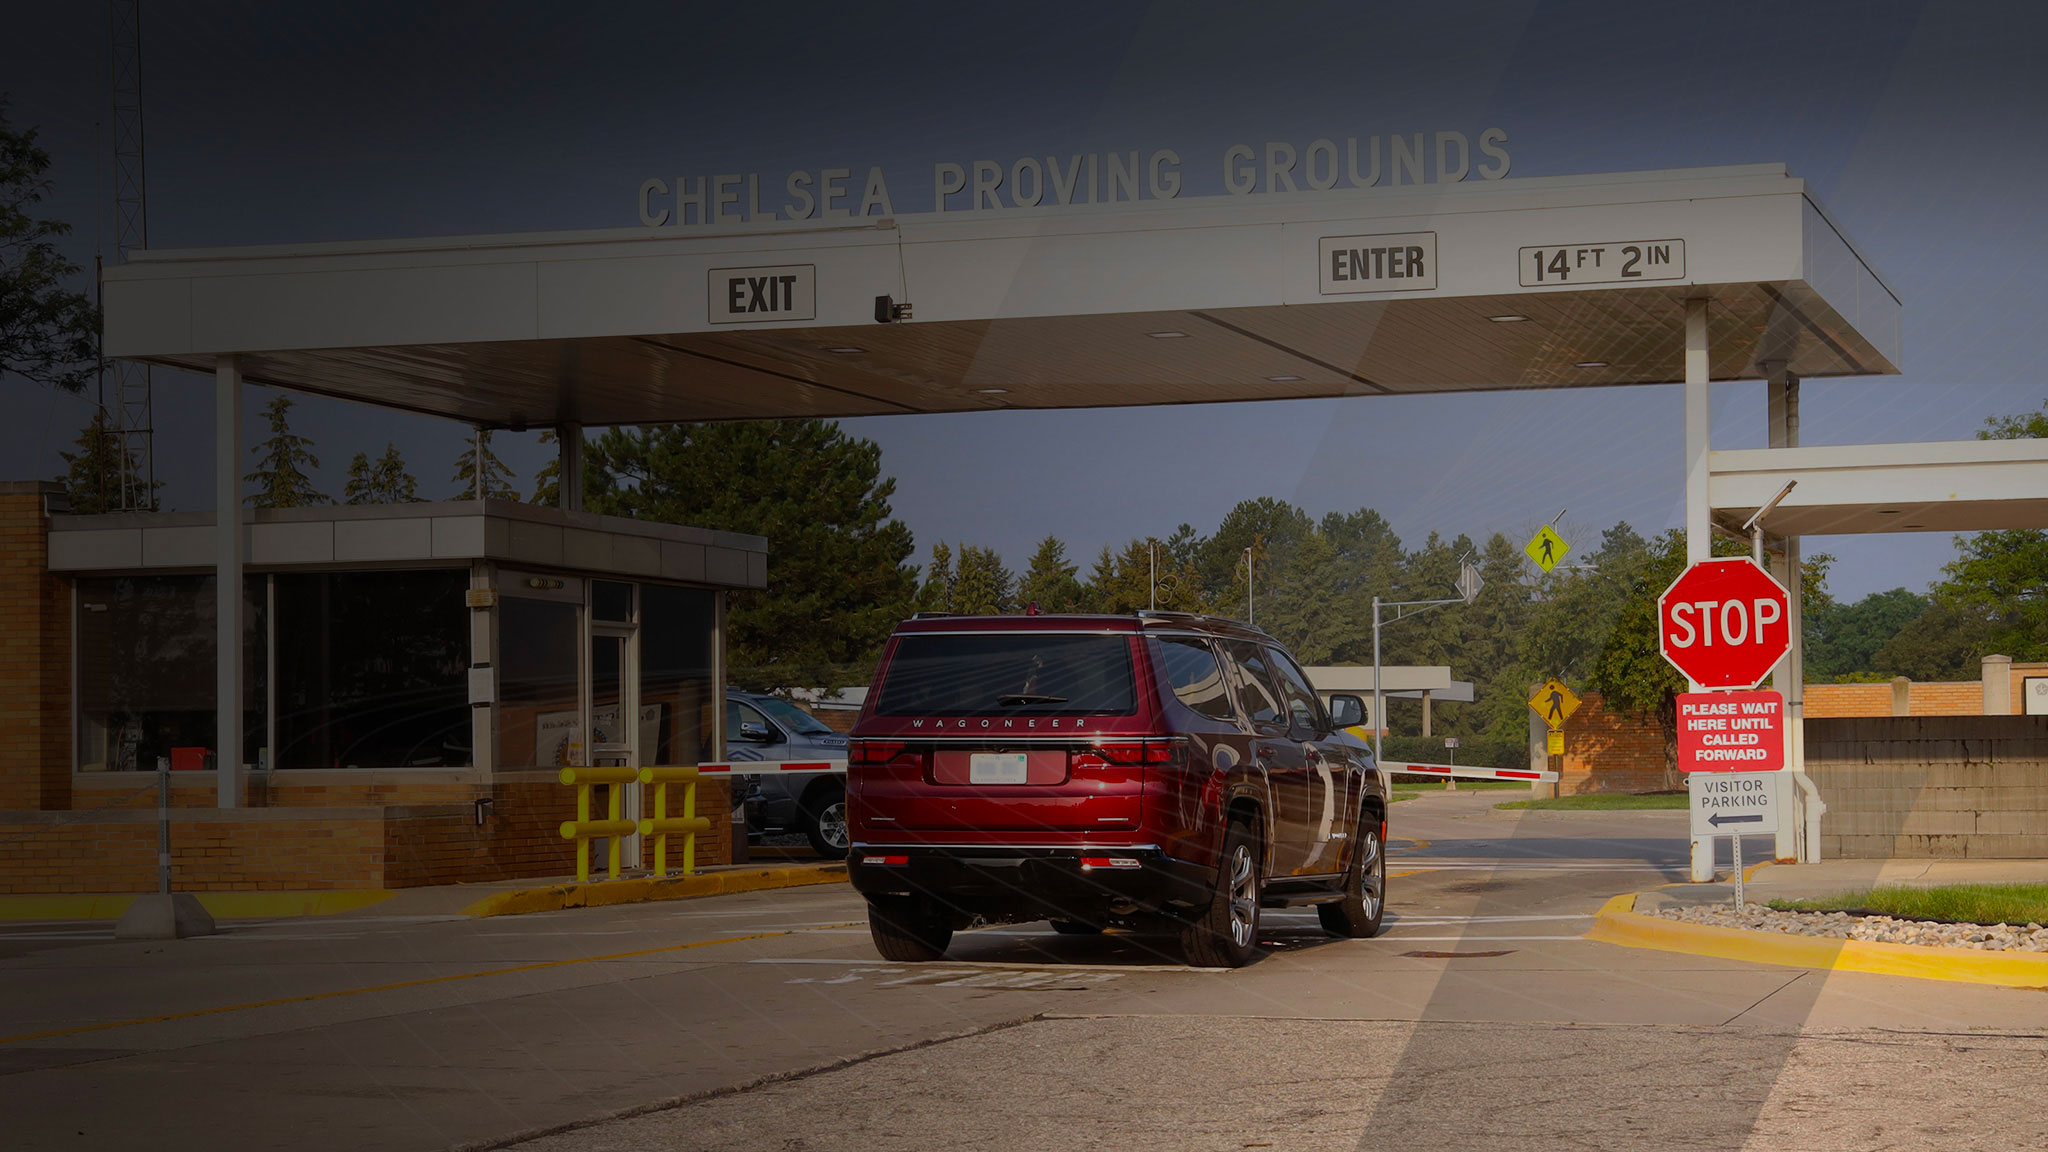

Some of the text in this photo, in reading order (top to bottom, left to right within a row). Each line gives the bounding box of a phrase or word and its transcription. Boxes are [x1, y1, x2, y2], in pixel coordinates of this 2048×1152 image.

[638, 128, 1512, 227] CHELSEA PROVING GROUNDS
[1332, 246, 1425, 281] ENTER
[728, 275, 797, 314] EXIT
[1669, 598, 1781, 649] STOP
[1682, 702, 1778, 716] PLEASE WAIT
[912, 719, 1086, 728] WAGONEER
[1687, 718, 1774, 731] HERE UNTIL
[1702, 733, 1759, 746] CALLED
[1695, 748, 1767, 761] FORWARD
[1704, 780, 1763, 793] VISITOR
[1702, 794, 1768, 808] PARKING
